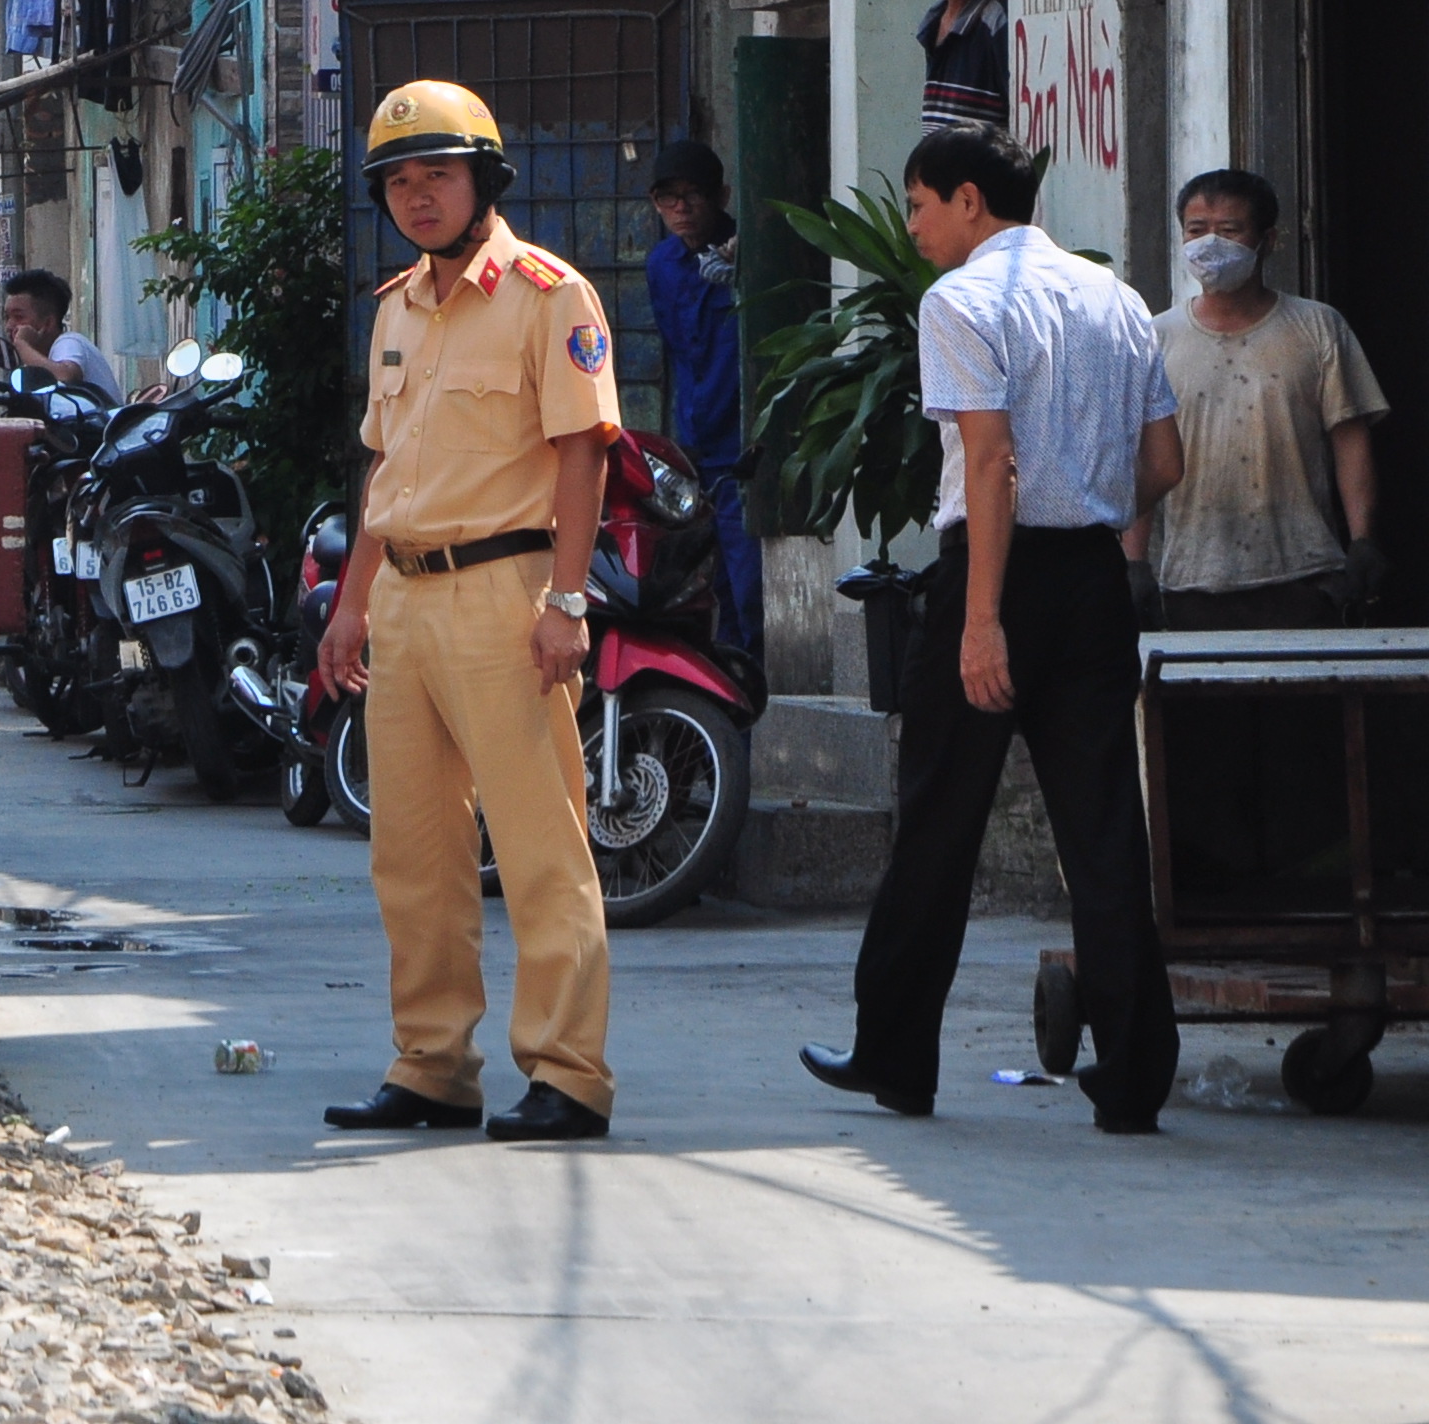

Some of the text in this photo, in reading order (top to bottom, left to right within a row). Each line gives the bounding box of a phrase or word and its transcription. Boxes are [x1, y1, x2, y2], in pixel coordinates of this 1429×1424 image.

[1015, 4, 1119, 171] Bán Nhà
[136, 569, 185, 598] 15-B2
[132, 588, 196, 620] 746.63
